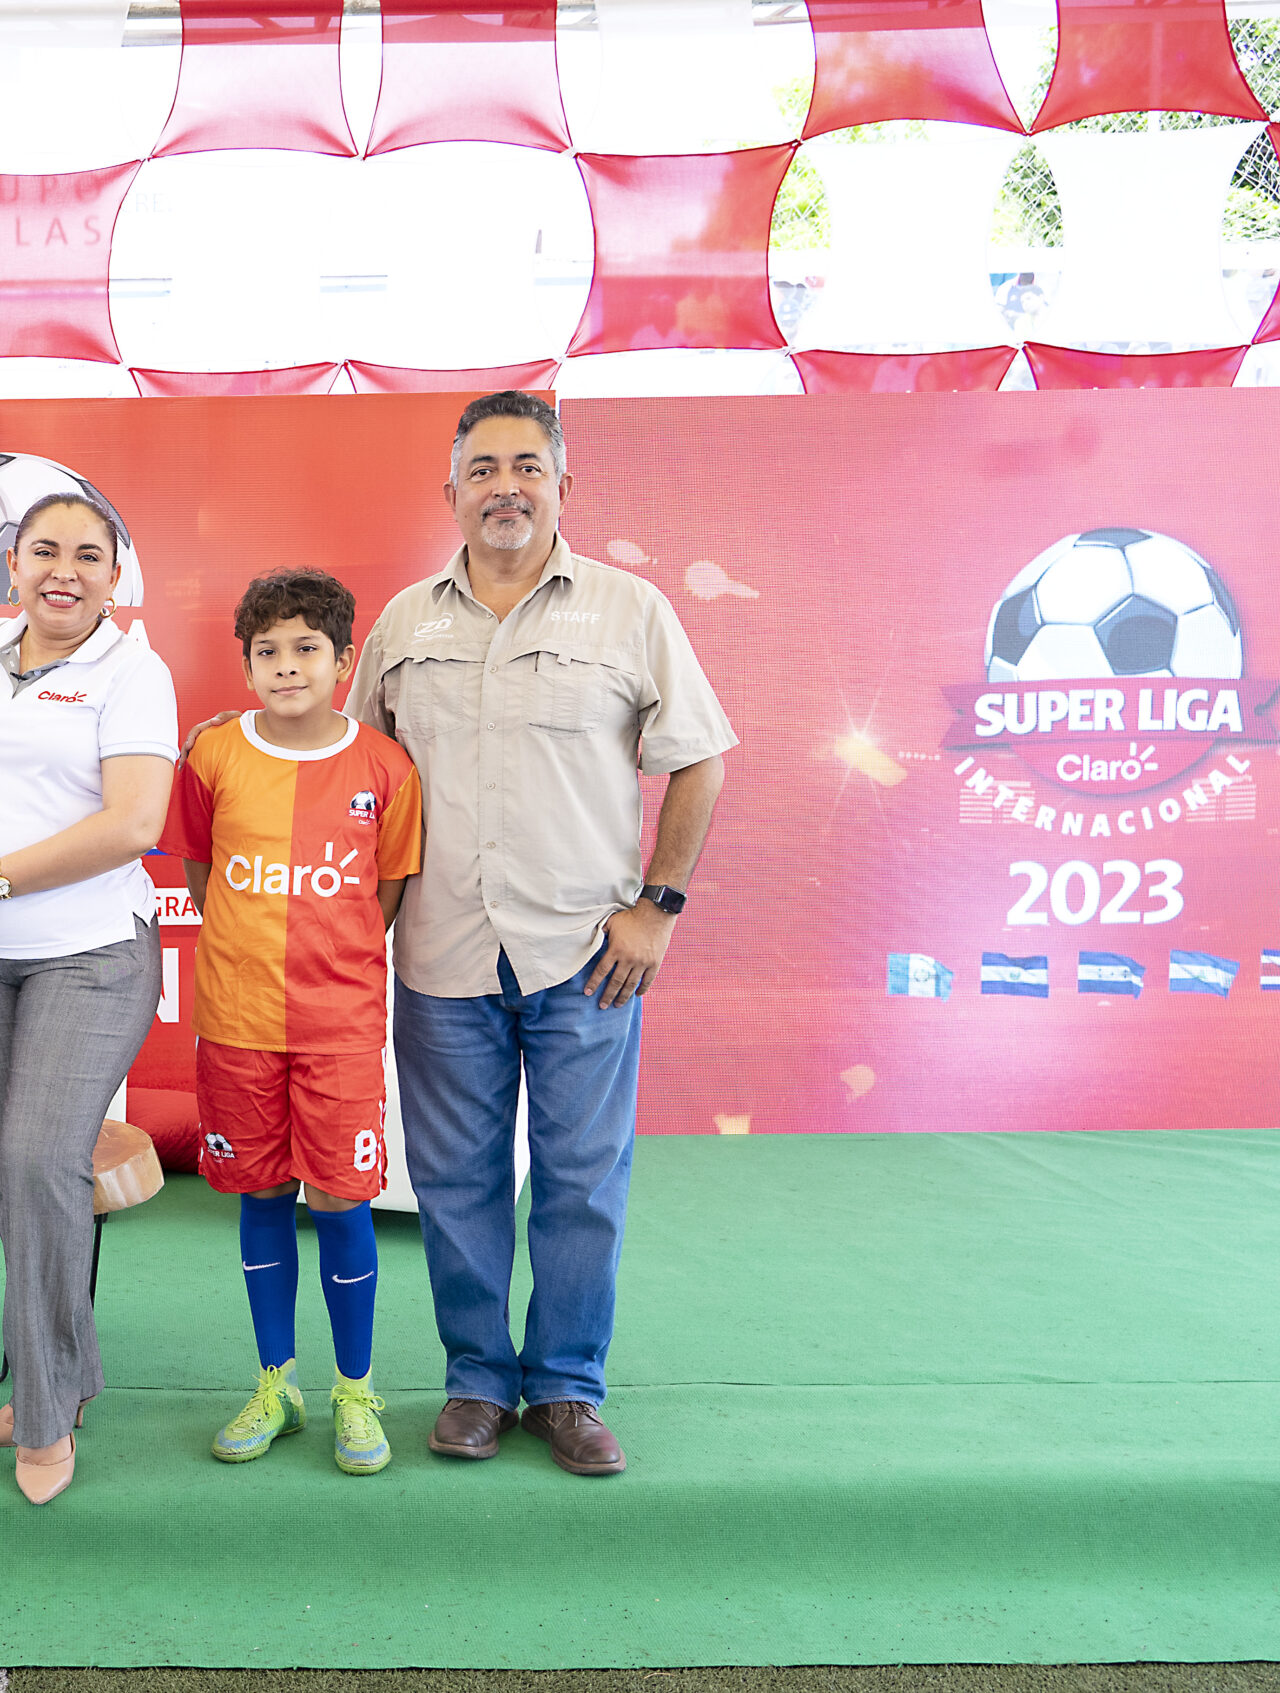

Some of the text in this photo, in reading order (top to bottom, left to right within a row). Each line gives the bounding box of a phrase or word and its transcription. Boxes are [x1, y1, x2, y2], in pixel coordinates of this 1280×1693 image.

[550, 610, 601, 624] STAFF
[38, 691, 87, 703] Claro
[975, 688, 1243, 737] SUPER LIGA
[1057, 742, 1158, 782] Claro
[349, 809, 369, 818] SUPER
[954, 753, 1251, 838] INTERNACIONAL
[226, 842, 360, 897] Claro
[1006, 859, 1185, 926] 2023
[221, 1151, 235, 1159] LIGA
[353, 1129, 378, 1172] 8
